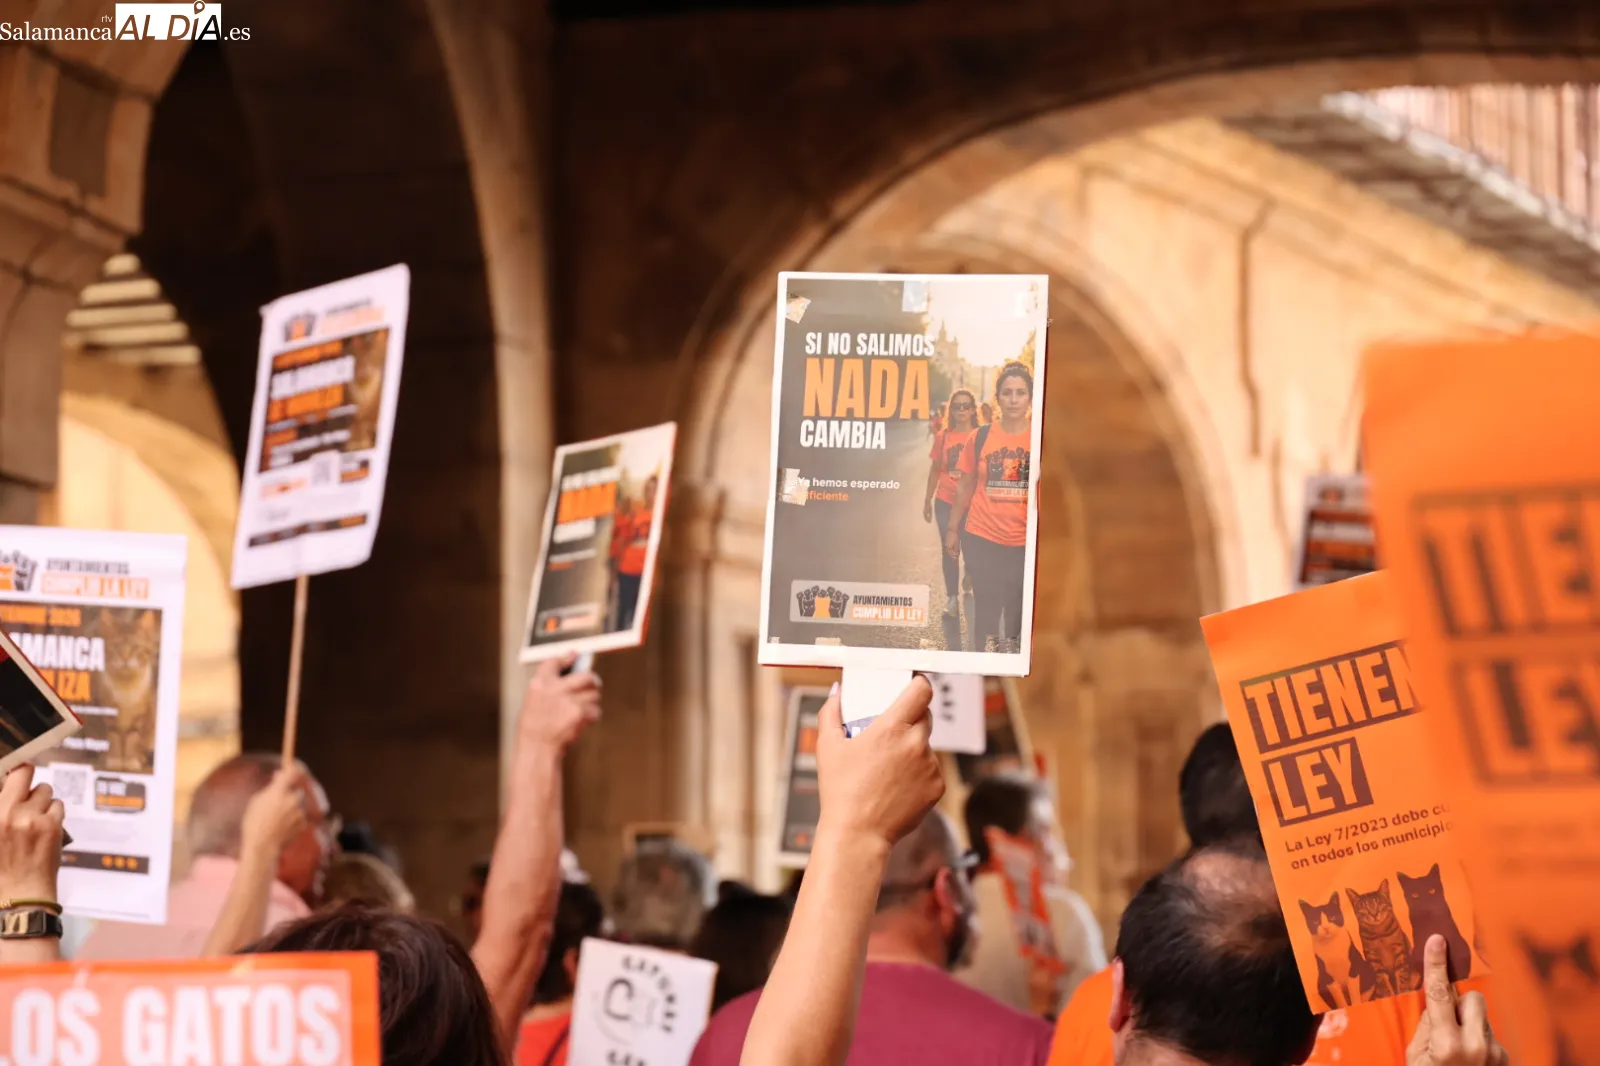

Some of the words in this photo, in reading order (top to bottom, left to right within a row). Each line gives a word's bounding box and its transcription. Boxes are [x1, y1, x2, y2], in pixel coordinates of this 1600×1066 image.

[805, 332, 822, 355] SI
[827, 332, 851, 356] NO
[856, 333, 935, 357] SALIMOS
[803, 357, 930, 420] NADA
[800, 419, 886, 449] CAMBIA
[812, 477, 848, 488] hemos
[850, 478, 900, 491] esperado
[853, 595, 913, 607] AYUNTAMIENTOS
[893, 607, 904, 620] LA
[907, 607, 922, 620] LEY
[1267, 742, 1359, 822] LEY
[1285, 840, 1303, 853] La
[1306, 833, 1332, 848] Ley
[1335, 817, 1388, 841] 7/2023
[1391, 807, 1429, 826] debe
[1291, 858, 1310, 870] en
[1312, 846, 1354, 865] todos
[1356, 841, 1379, 855] los
[0, 985, 99, 1066] OS
[123, 984, 341, 1066] GATOS
